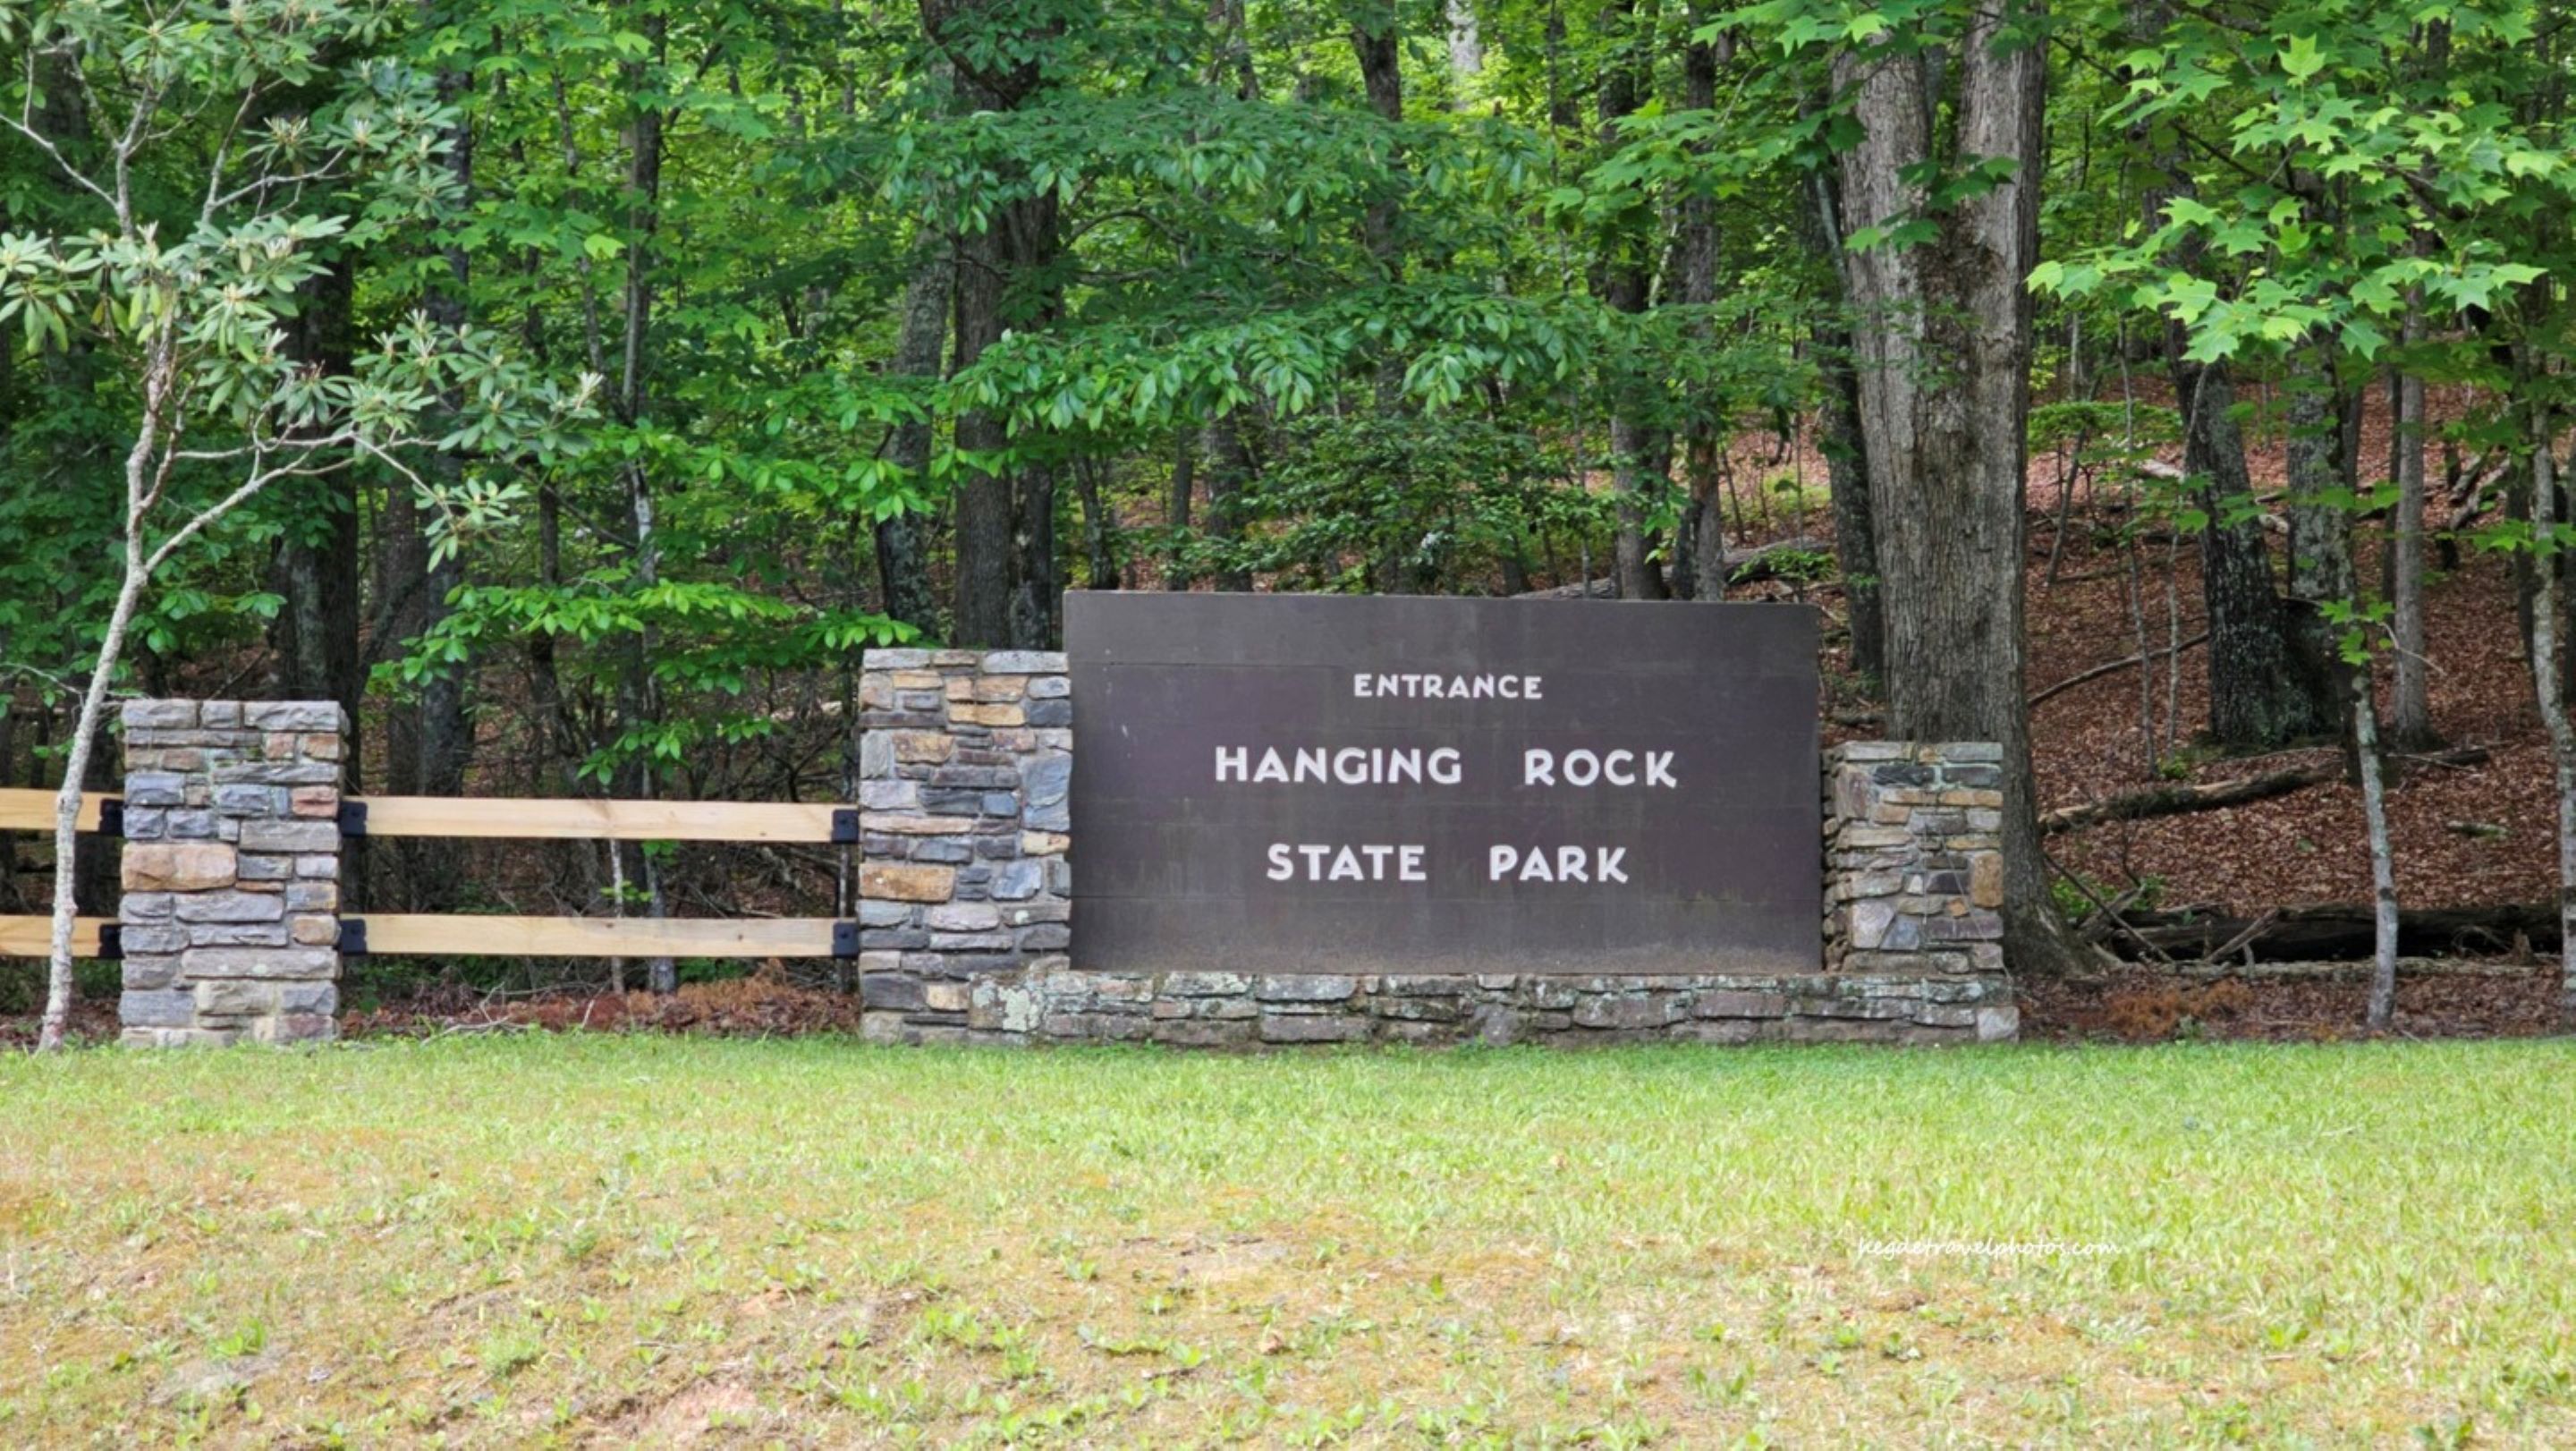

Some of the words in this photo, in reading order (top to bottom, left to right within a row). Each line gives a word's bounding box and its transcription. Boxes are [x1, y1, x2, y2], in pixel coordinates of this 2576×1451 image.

[1352, 672, 1545, 700] ENTRANCE
[1213, 744, 1463, 786] HANGING
[1523, 747, 1679, 790] ROCK
[1265, 842, 1428, 883] STATE
[1488, 844, 1631, 885] PARK
